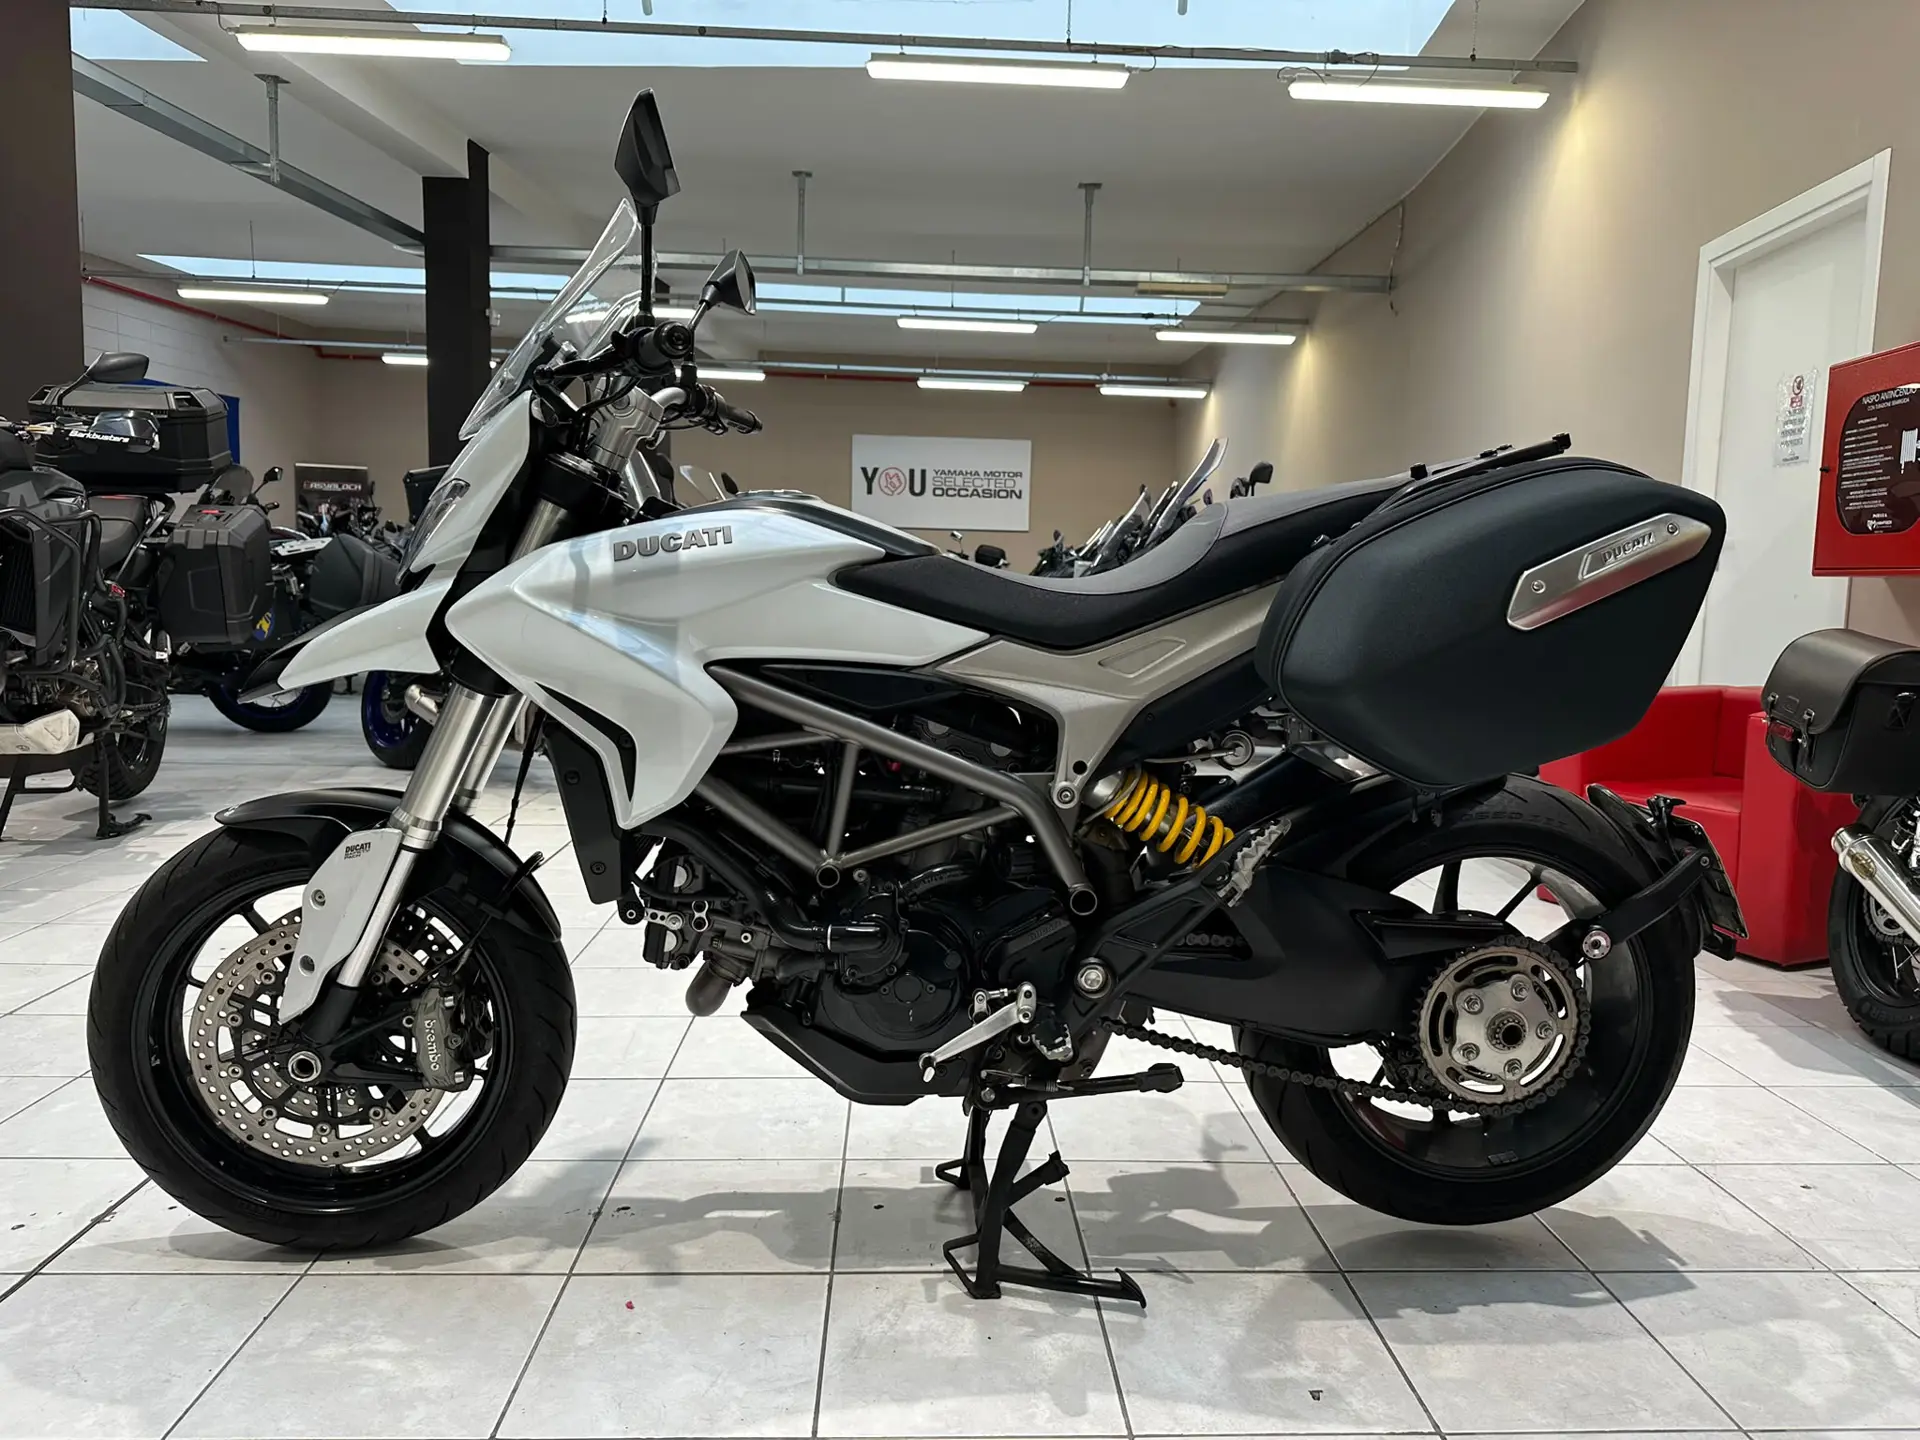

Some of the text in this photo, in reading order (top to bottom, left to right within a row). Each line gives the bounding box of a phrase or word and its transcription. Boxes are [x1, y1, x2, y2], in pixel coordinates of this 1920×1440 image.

[68, 429, 130, 443] Barkbusters
[933, 468, 1023, 478] YAMAHA MOTOR
[932, 477, 1016, 489] SELECTED
[932, 487, 1023, 499] OCCASION
[613, 525, 733, 562] DUCATI
[1602, 531, 1655, 565] DUCATI
[345, 841, 371, 853] DUCATI
[424, 1019, 441, 1071] brembo
